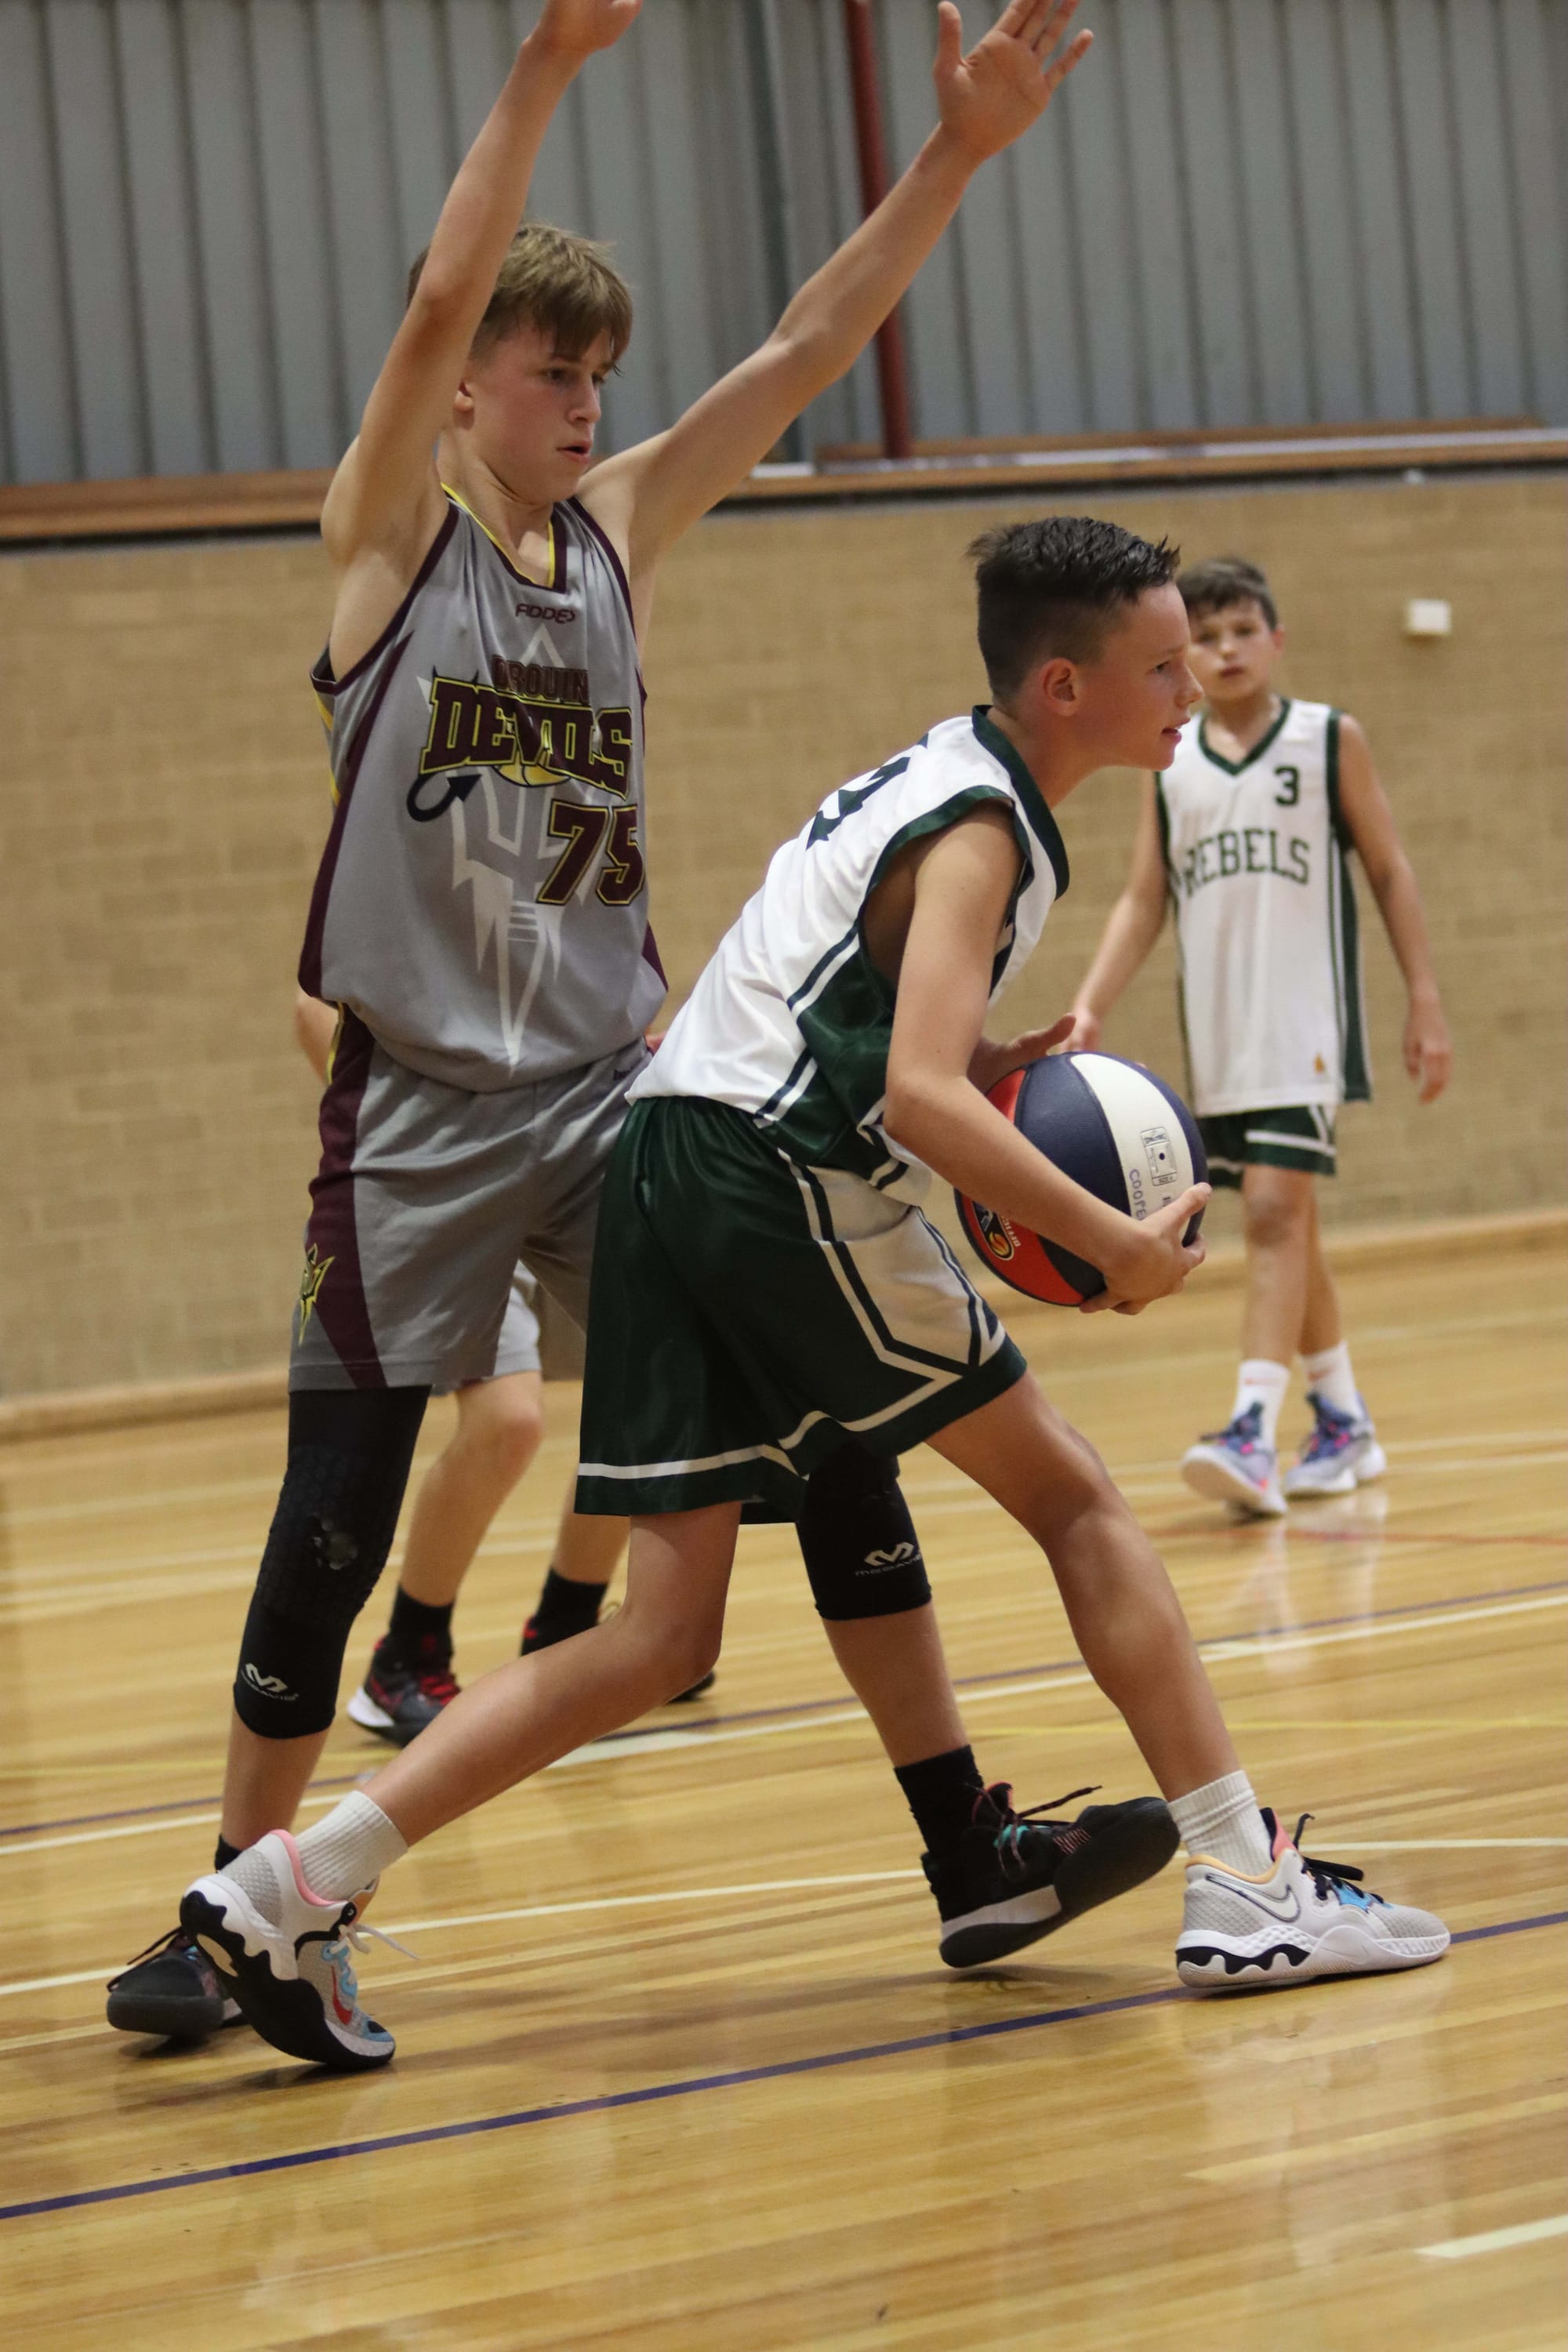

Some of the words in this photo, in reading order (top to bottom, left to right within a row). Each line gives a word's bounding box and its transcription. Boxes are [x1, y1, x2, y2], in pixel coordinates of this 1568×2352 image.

[419, 677, 632, 801] DEVILS
[1274, 766, 1300, 807] 3
[536, 799, 645, 906] 75
